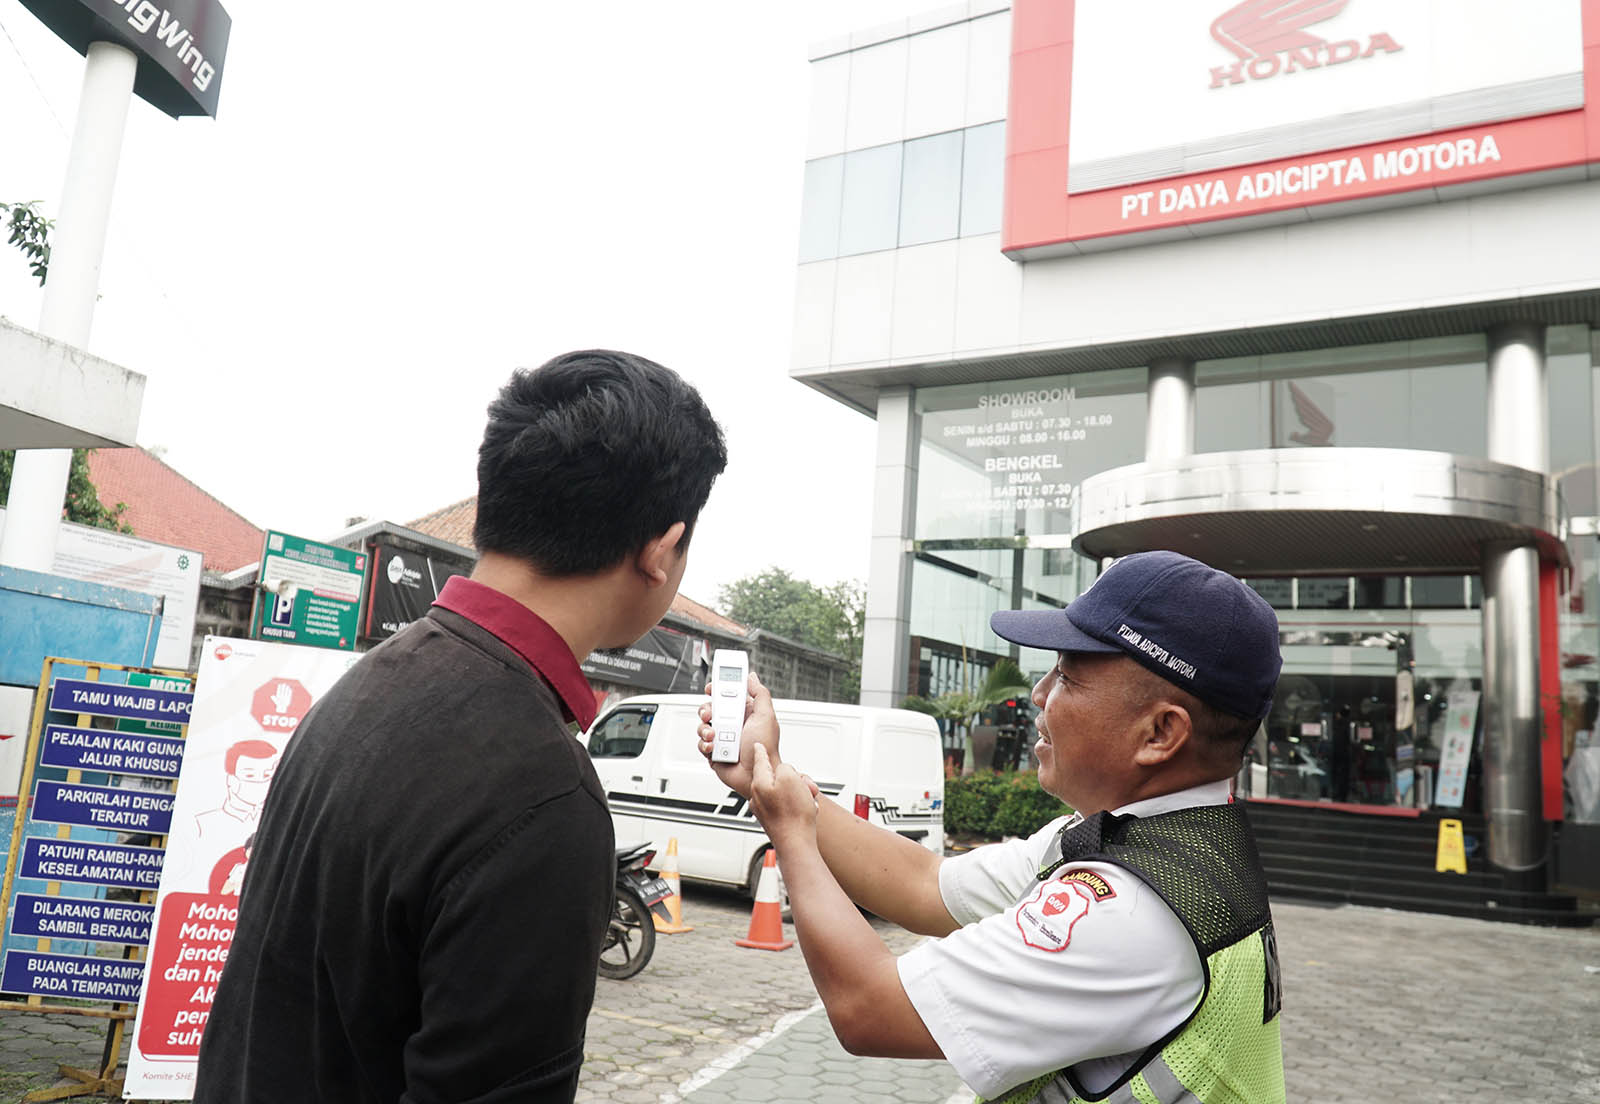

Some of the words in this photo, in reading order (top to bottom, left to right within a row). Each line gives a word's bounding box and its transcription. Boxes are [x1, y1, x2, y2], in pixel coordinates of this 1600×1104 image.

[112, 0, 216, 92] igWing
[1209, 32, 1404, 89] HONDA
[1121, 192, 1153, 219] PT
[1159, 180, 1229, 213] DAYA
[1236, 157, 1367, 201] ADICIPTA
[1373, 135, 1501, 180] MOTORA
[978, 387, 1076, 409] SHOWROOM
[1011, 407, 1044, 419] BUKA
[996, 421, 1033, 433] SABTU
[966, 435, 1010, 447] MINGGU
[985, 454, 1063, 472] BENGKEL
[1008, 472, 1042, 484] BUKA
[72, 690, 110, 706] TAMU
[113, 694, 156, 711] WAJIB
[262, 714, 297, 728] STOP
[51, 731, 111, 750] PEJALAN
[113, 738, 144, 753] KAKI
[147, 742, 183, 757] GUNA
[79, 752, 121, 767] JALUR
[124, 757, 177, 772] KHUSUS
[56, 789, 130, 808] PARKIRLAH
[90, 809, 149, 826] TERATUR
[38, 844, 84, 860] PATUHI
[38, 861, 134, 882] KESELAMATAN
[33, 901, 100, 919] DILARANG
[188, 902, 238, 921] Moho
[38, 919, 87, 934] SAMBIL
[90, 924, 149, 940] BERJALA
[177, 943, 229, 963] jende
[27, 959, 100, 976] BUANGLAH
[164, 964, 200, 982] dan
[32, 977, 68, 991] PADA
[142, 1072, 174, 1081] Komite
